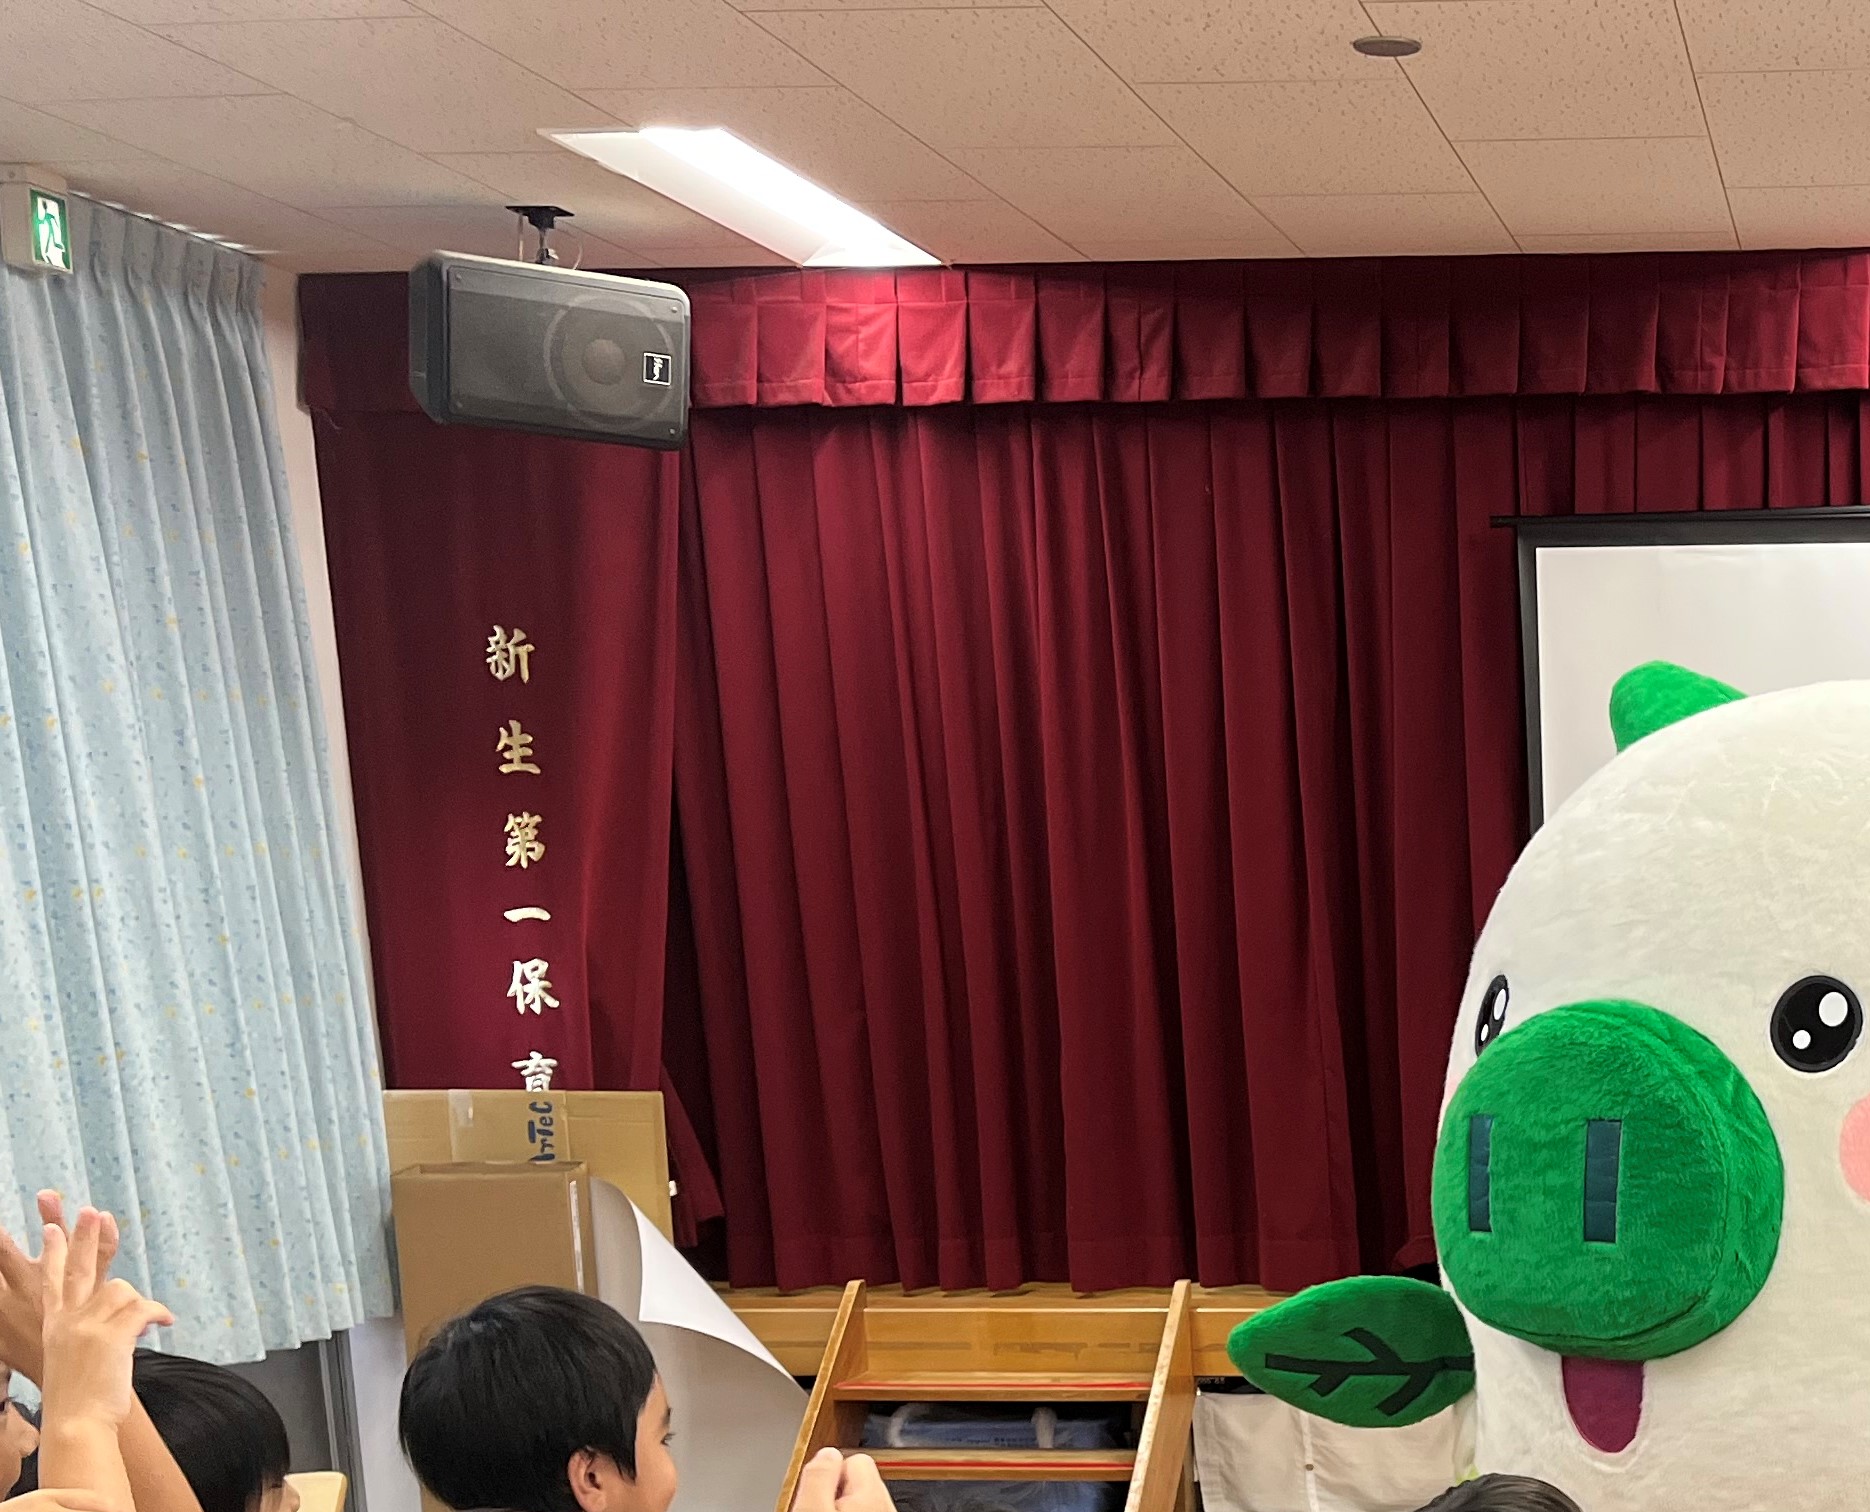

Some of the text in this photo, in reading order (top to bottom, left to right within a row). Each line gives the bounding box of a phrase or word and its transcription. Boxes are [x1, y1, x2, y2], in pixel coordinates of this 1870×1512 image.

[485, 624, 561, 1092] 新生第一保育
